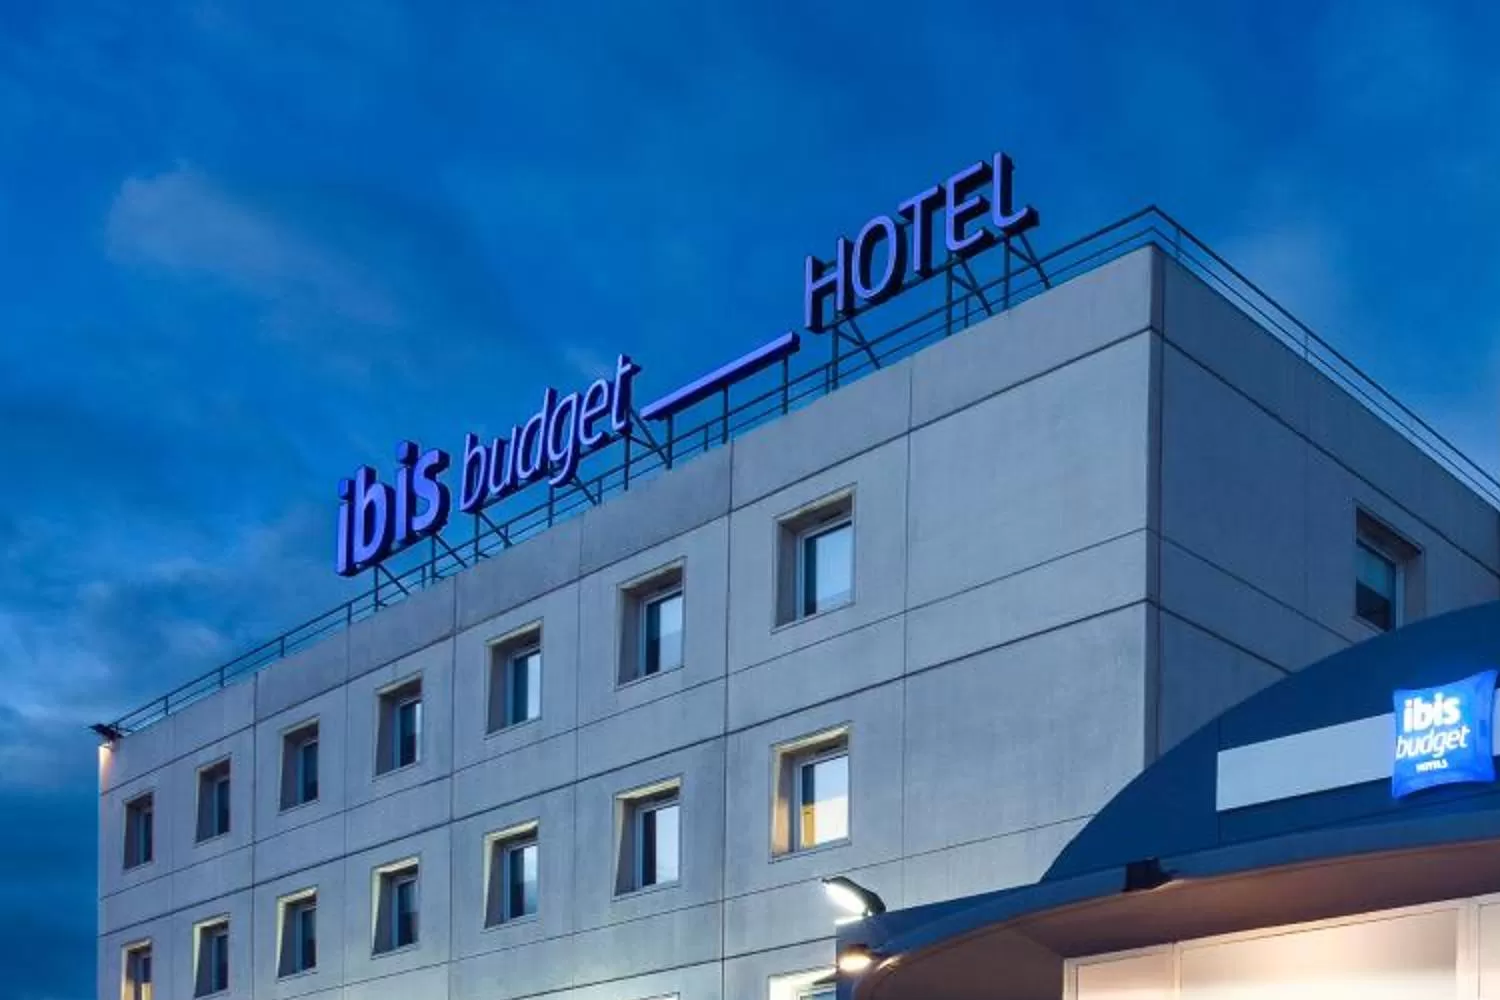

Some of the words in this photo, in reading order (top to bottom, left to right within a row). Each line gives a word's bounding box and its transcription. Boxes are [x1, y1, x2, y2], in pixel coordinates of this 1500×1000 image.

[336, 440, 449, 576] ibis
[460, 353, 640, 512] budget
[804, 151, 1037, 332] HOTEL
[1403, 692, 1460, 732] ibis
[1395, 725, 1471, 761] budget
